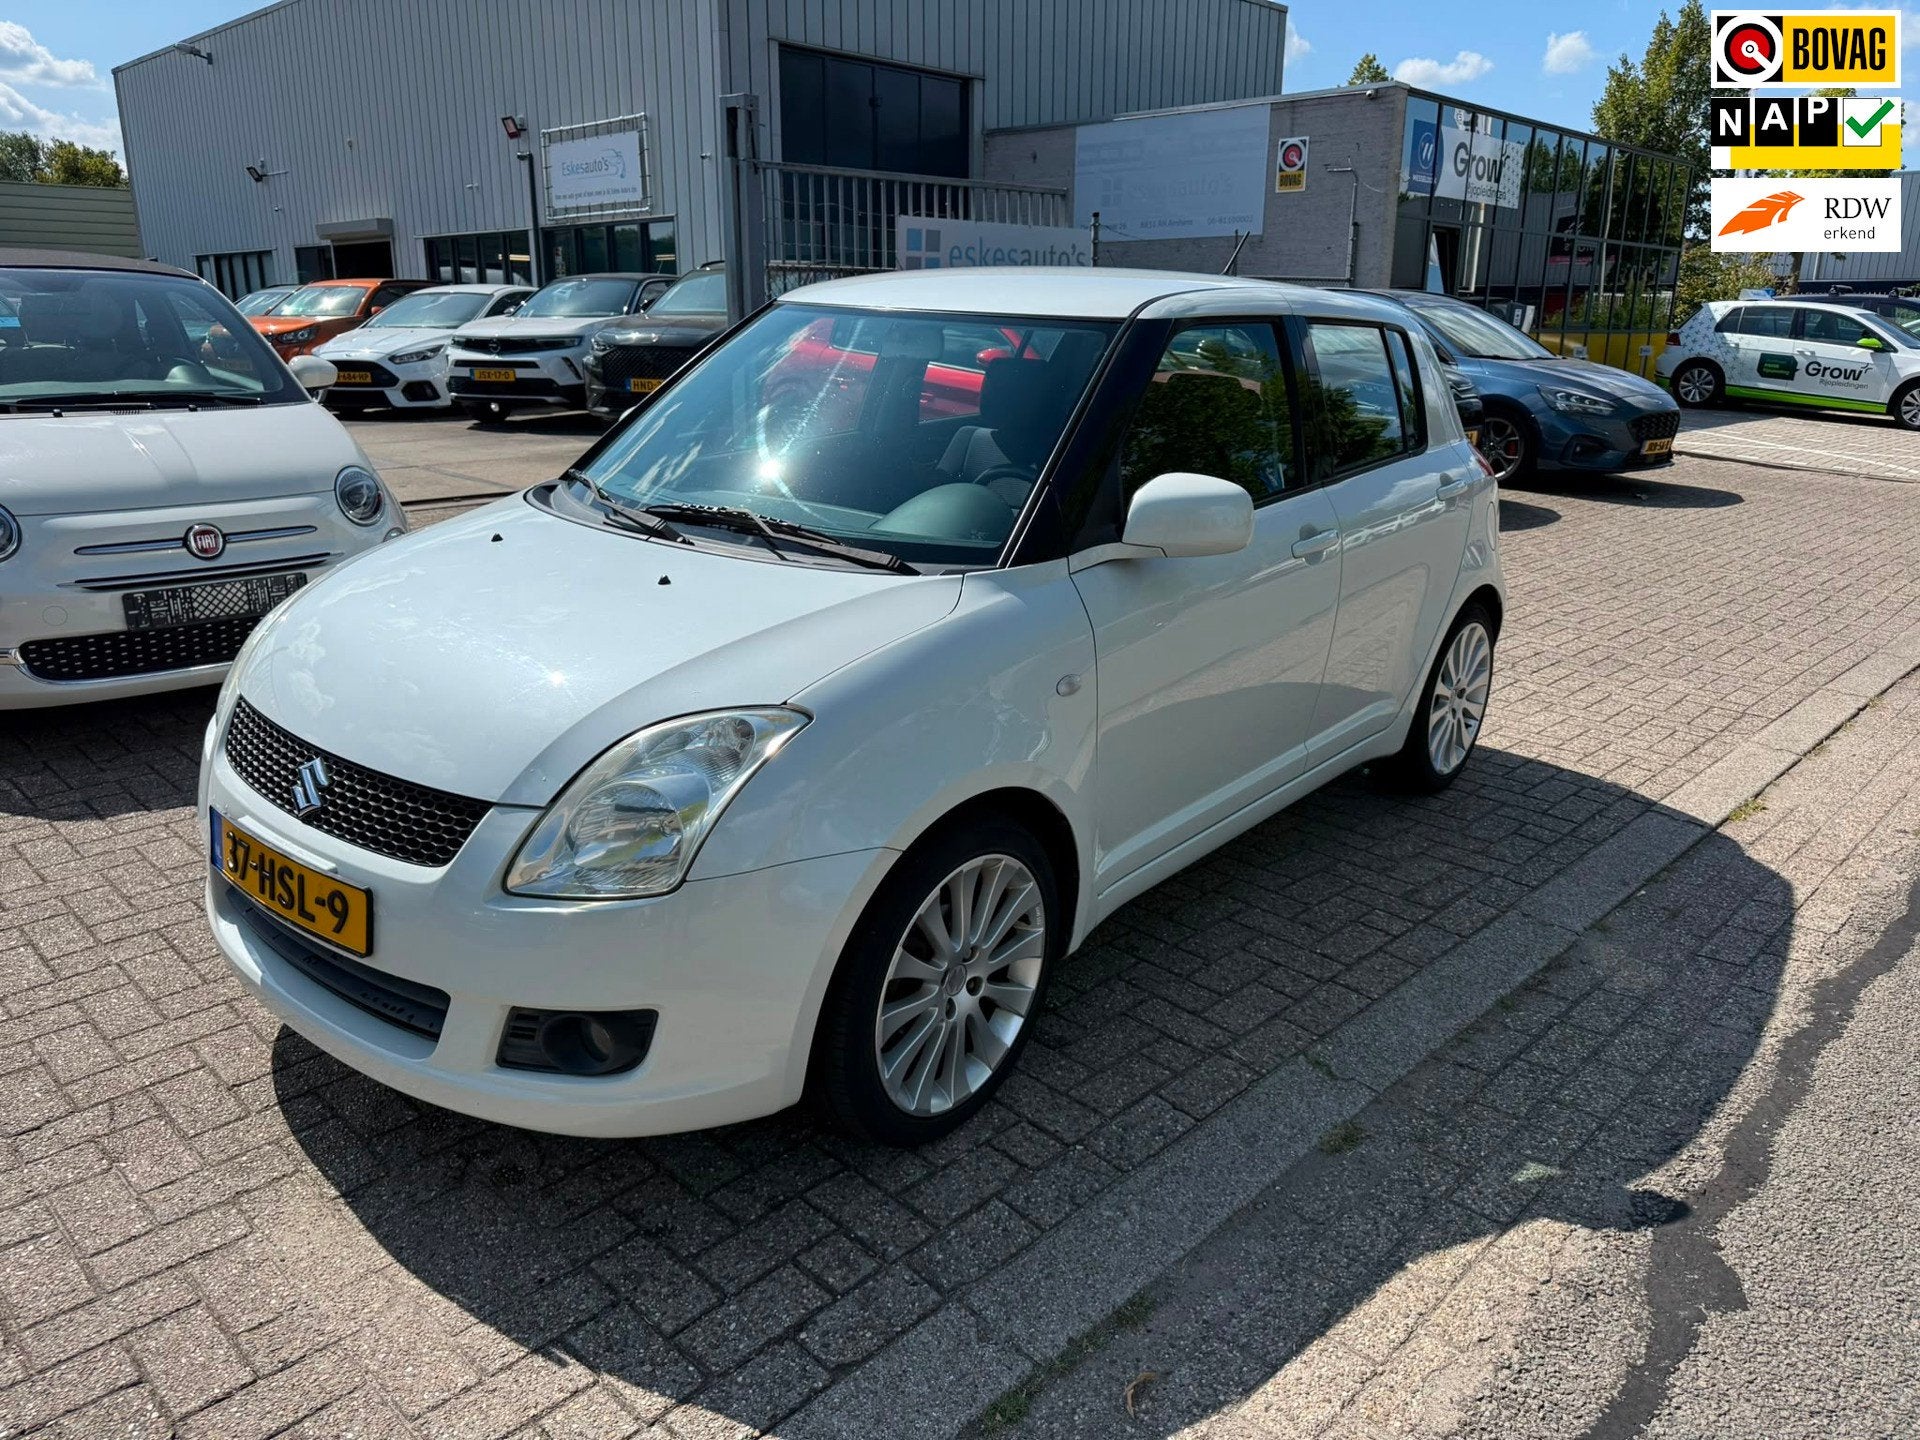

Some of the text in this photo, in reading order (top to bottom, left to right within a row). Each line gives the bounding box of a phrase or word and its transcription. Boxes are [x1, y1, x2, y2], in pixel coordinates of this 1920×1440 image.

[561, 157, 610, 177] Eskesauto's
[1454, 142, 1504, 184] Grow
[1279, 173, 1302, 187] BOVAG
[951, 237, 1087, 267] eskesauto's
[1805, 361, 1863, 381] Grow
[1819, 379, 1869, 390] Rijopleidingen
[196, 533, 216, 550] FIAT
[226, 831, 349, 934] 37-HSL-9
